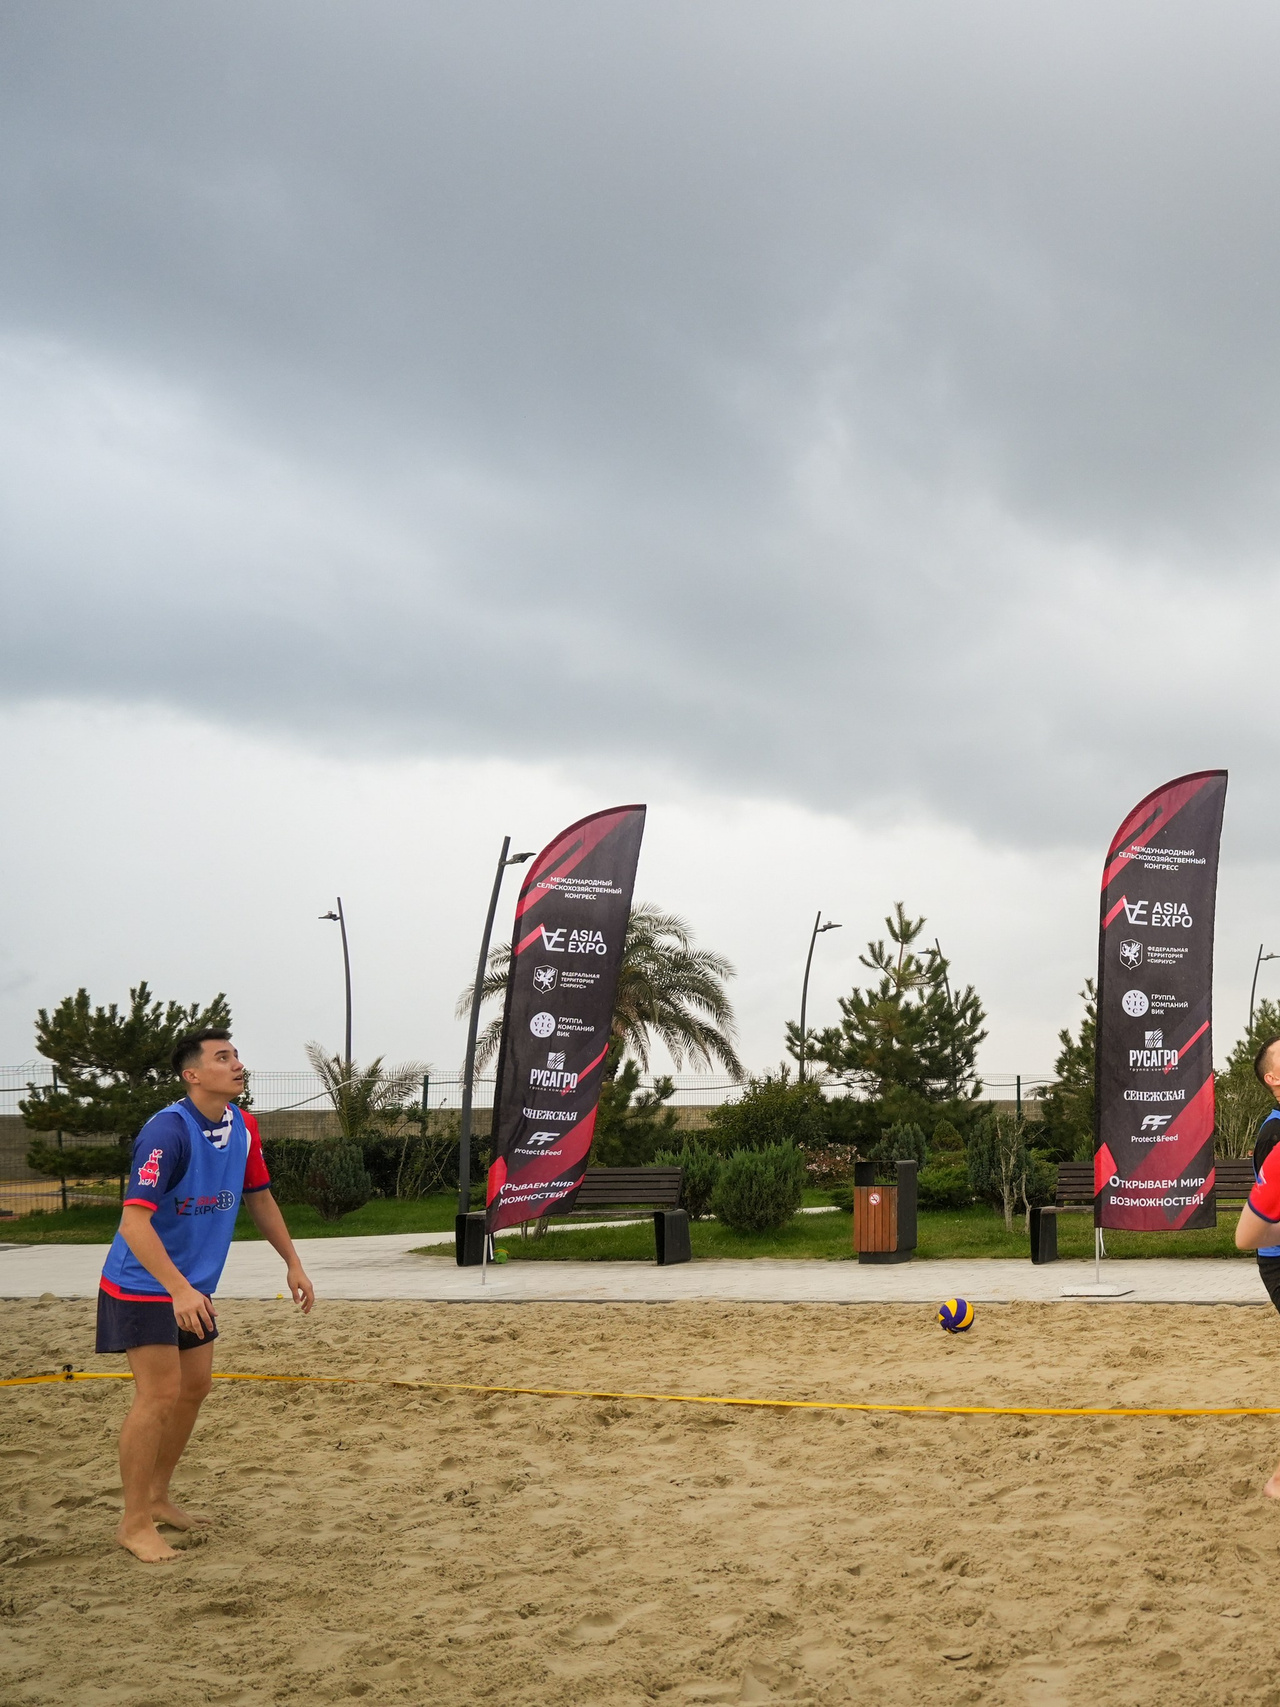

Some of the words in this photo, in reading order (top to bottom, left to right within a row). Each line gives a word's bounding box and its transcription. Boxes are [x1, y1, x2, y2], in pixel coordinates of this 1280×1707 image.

[1131, 845, 1195, 856] МЕЖДУНАРОДНЫЙ
[1118, 851, 1206, 864] СЕЛЬСКОХОЗЯЙСТВЕННЫЙ
[1144, 862, 1179, 871] КОНГРЕСС
[550, 877, 612, 886] МЕЖДУНАРОДНЫЙ
[536, 882, 622, 894] СЕЛЬСКОХОЗЯЙСТВЕННЫЙ
[1152, 902, 1189, 915] ASIA
[1151, 914, 1193, 928] EXPO
[569, 929, 604, 943] ASIA
[567, 941, 607, 955] EXPO
[1151, 993, 1176, 1001] ГРУППА
[557, 1024, 595, 1032] КОМПАНИЙ
[1129, 1049, 1179, 1067] РУСАГРО
[529, 1068, 578, 1089] РУСАГРО
[1123, 1089, 1186, 1102] СЕНЕЖСКАЯ
[1130, 1134, 1179, 1143] Protect&Feed
[514, 1147, 562, 1156] Protect&Feed
